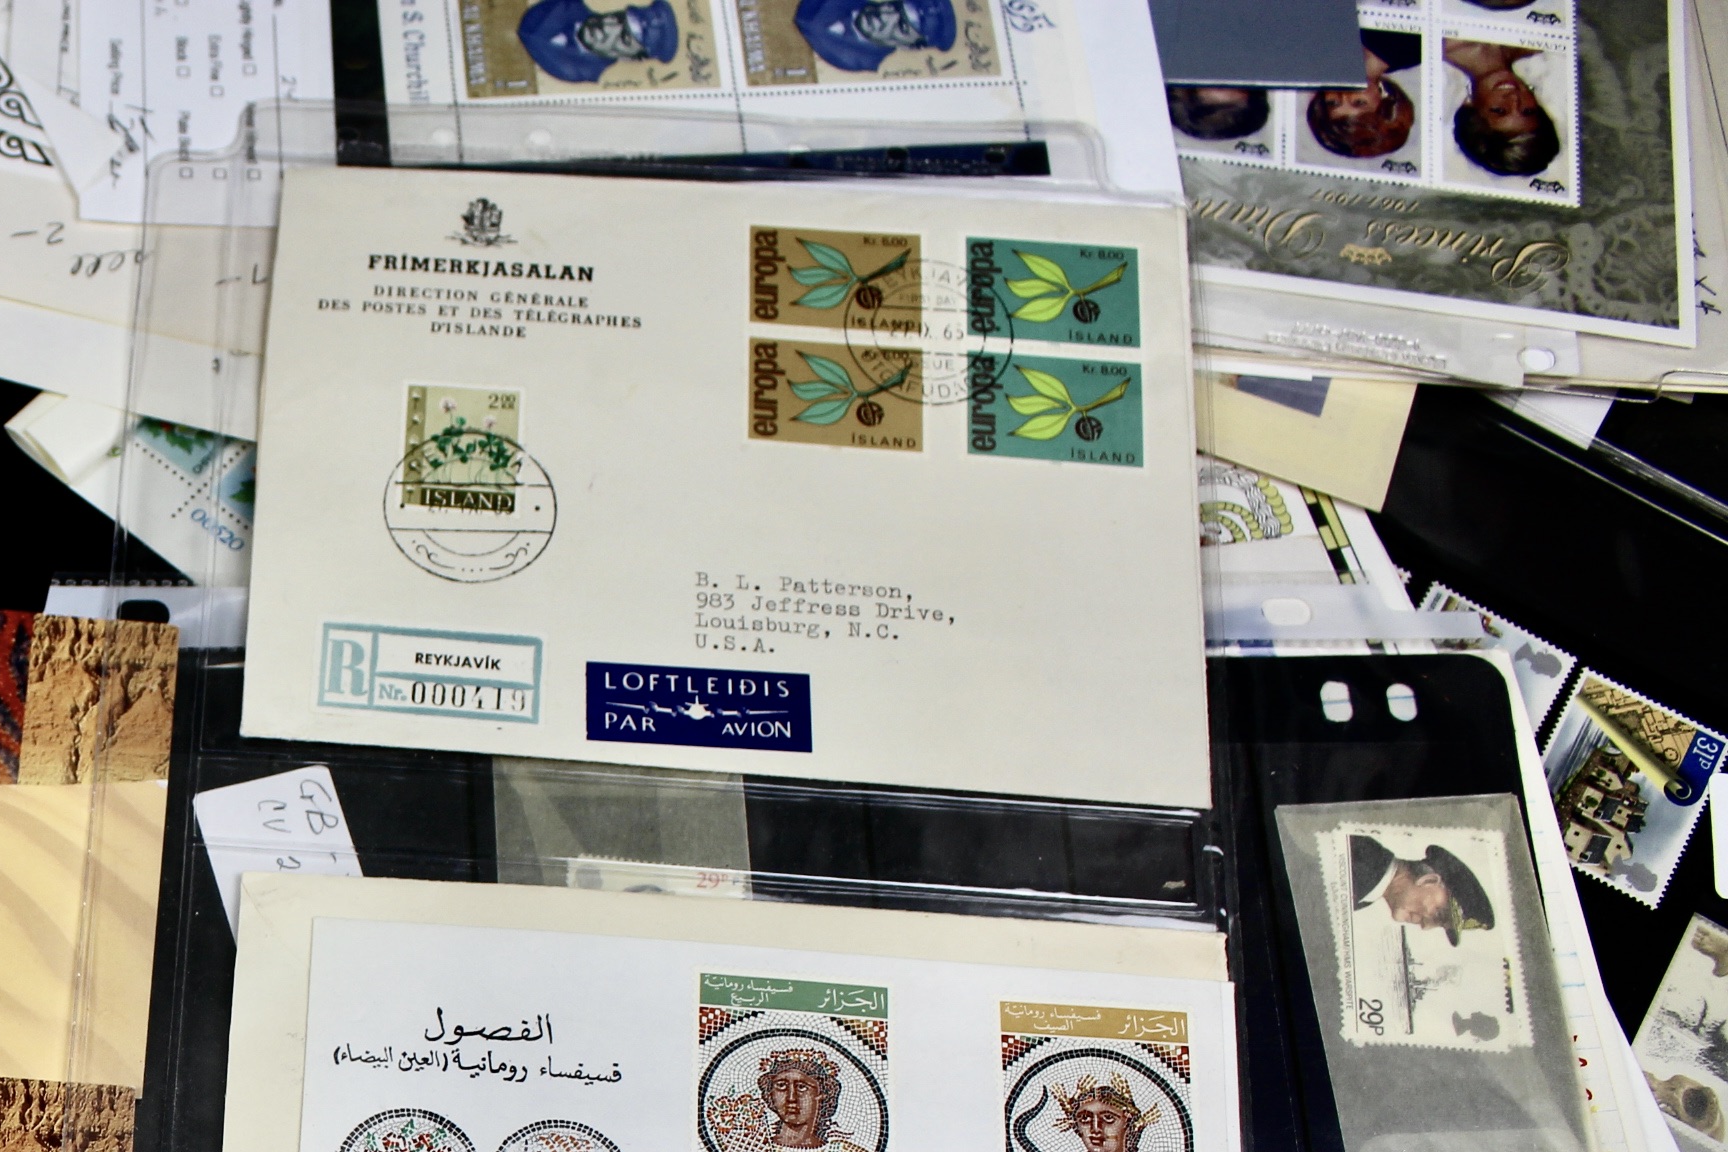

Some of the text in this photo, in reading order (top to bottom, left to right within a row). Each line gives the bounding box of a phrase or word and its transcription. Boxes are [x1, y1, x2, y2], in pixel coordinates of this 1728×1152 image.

[1364, 220, 1571, 292] Princess
[752, 228, 787, 322] europa
[971, 240, 1003, 335] europa
[373, 284, 480, 302] DIRECTION
[317, 298, 351, 311] DES
[362, 300, 428, 316] POSTES
[438, 304, 460, 318] ET
[470, 305, 503, 321] DES
[430, 320, 527, 339] D'ISLANDE
[752, 341, 787, 438] europa
[423, 487, 514, 511] ISLAND
[695, 571, 913, 602] B. L. Patterson,
[696, 592, 956, 626] 983 Jeffress Drive,
[694, 612, 900, 641] Louisburg, N.C.
[694, 633, 776, 654] U.S.A.
[325, 638, 369, 698] R
[414, 651, 501, 671] REYKJAVÍK
[378, 683, 408, 702] Nr.
[603, 711, 794, 740] PAR AVION
[424, 1006, 554, 1046] الفصول
